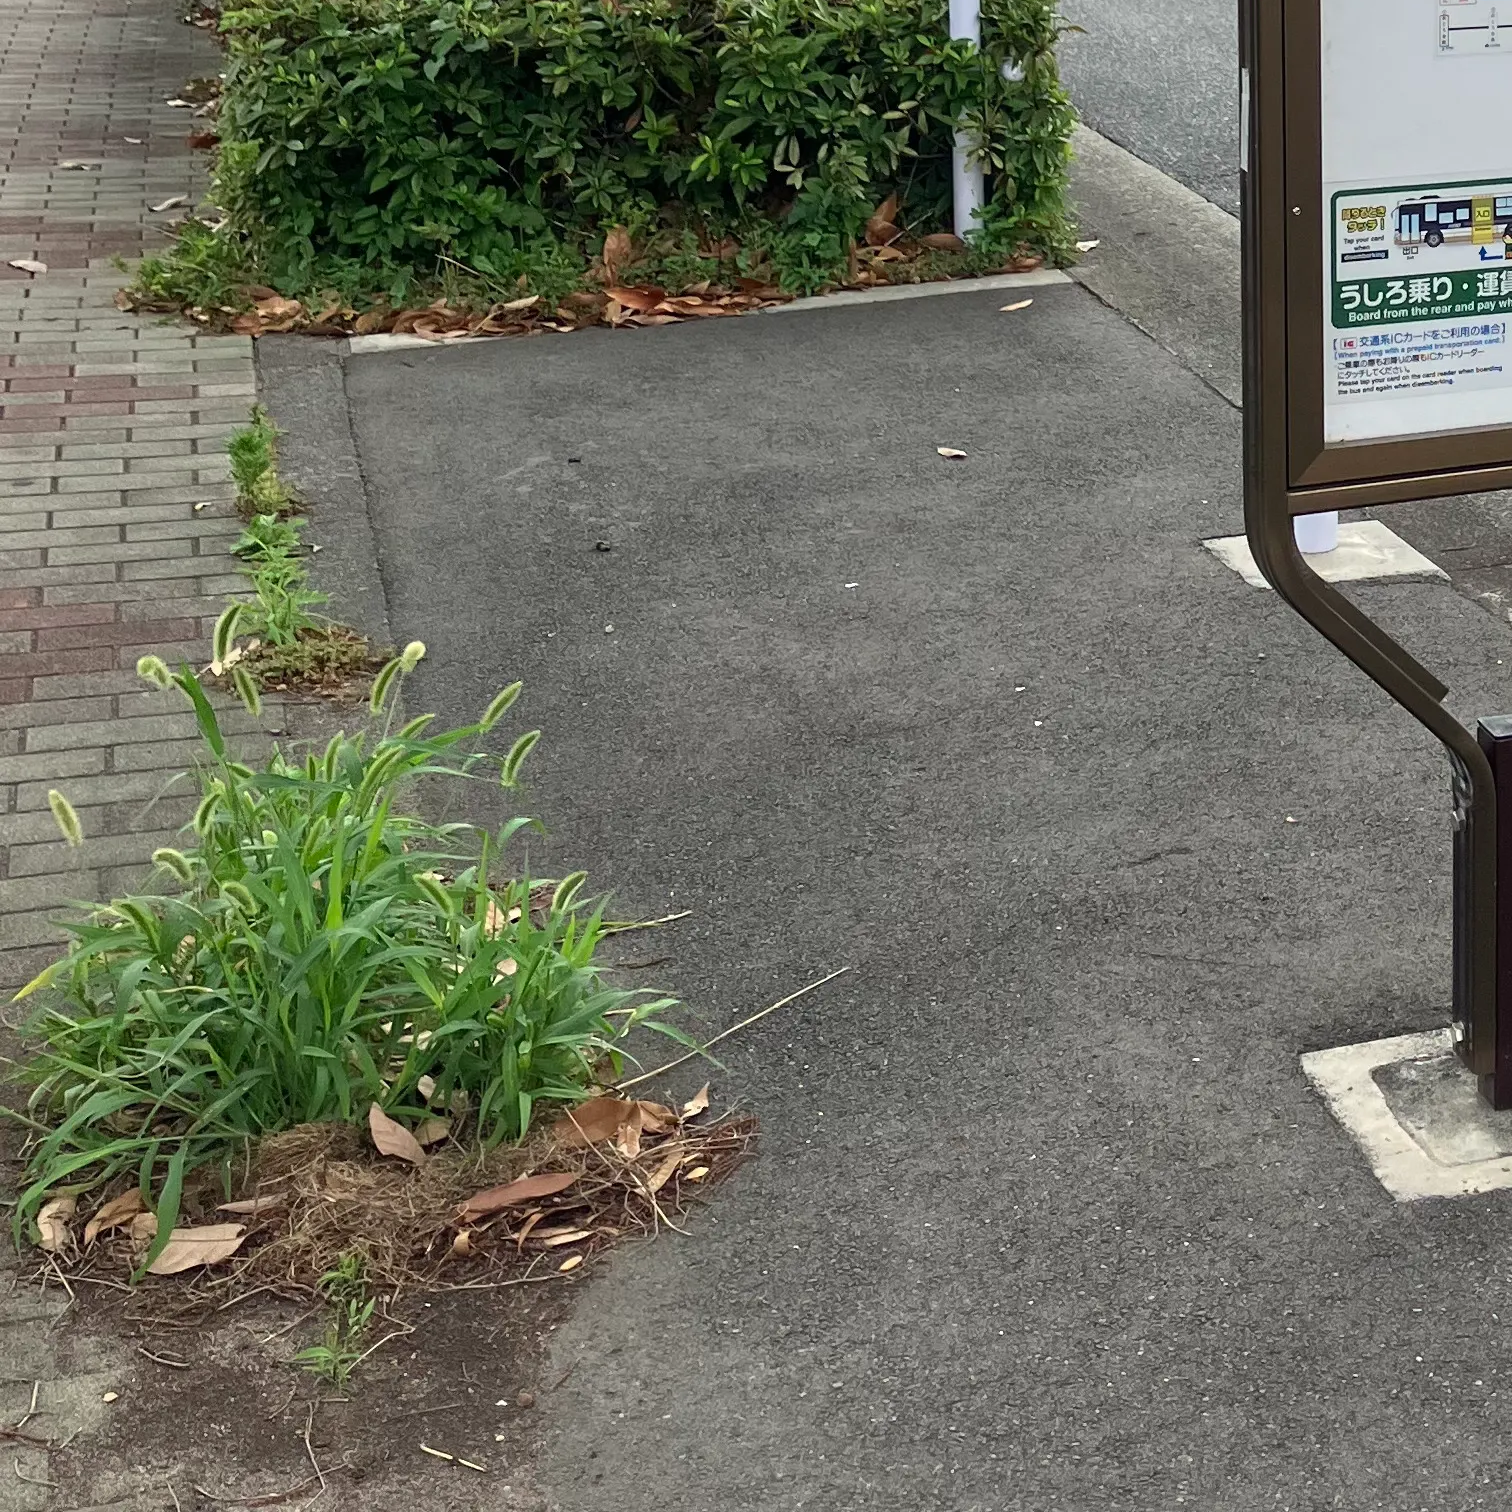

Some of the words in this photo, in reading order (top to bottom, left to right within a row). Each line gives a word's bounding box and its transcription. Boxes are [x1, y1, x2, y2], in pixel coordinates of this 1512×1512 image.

[1403, 246, 1418, 255] 出口
[1349, 309, 1381, 323] Board
[1384, 307, 1409, 319] from
[1411, 305, 1429, 316] the
[1430, 304, 1452, 315] rear
[1455, 301, 1475, 312] and
[1477, 300, 1496, 312] pay
